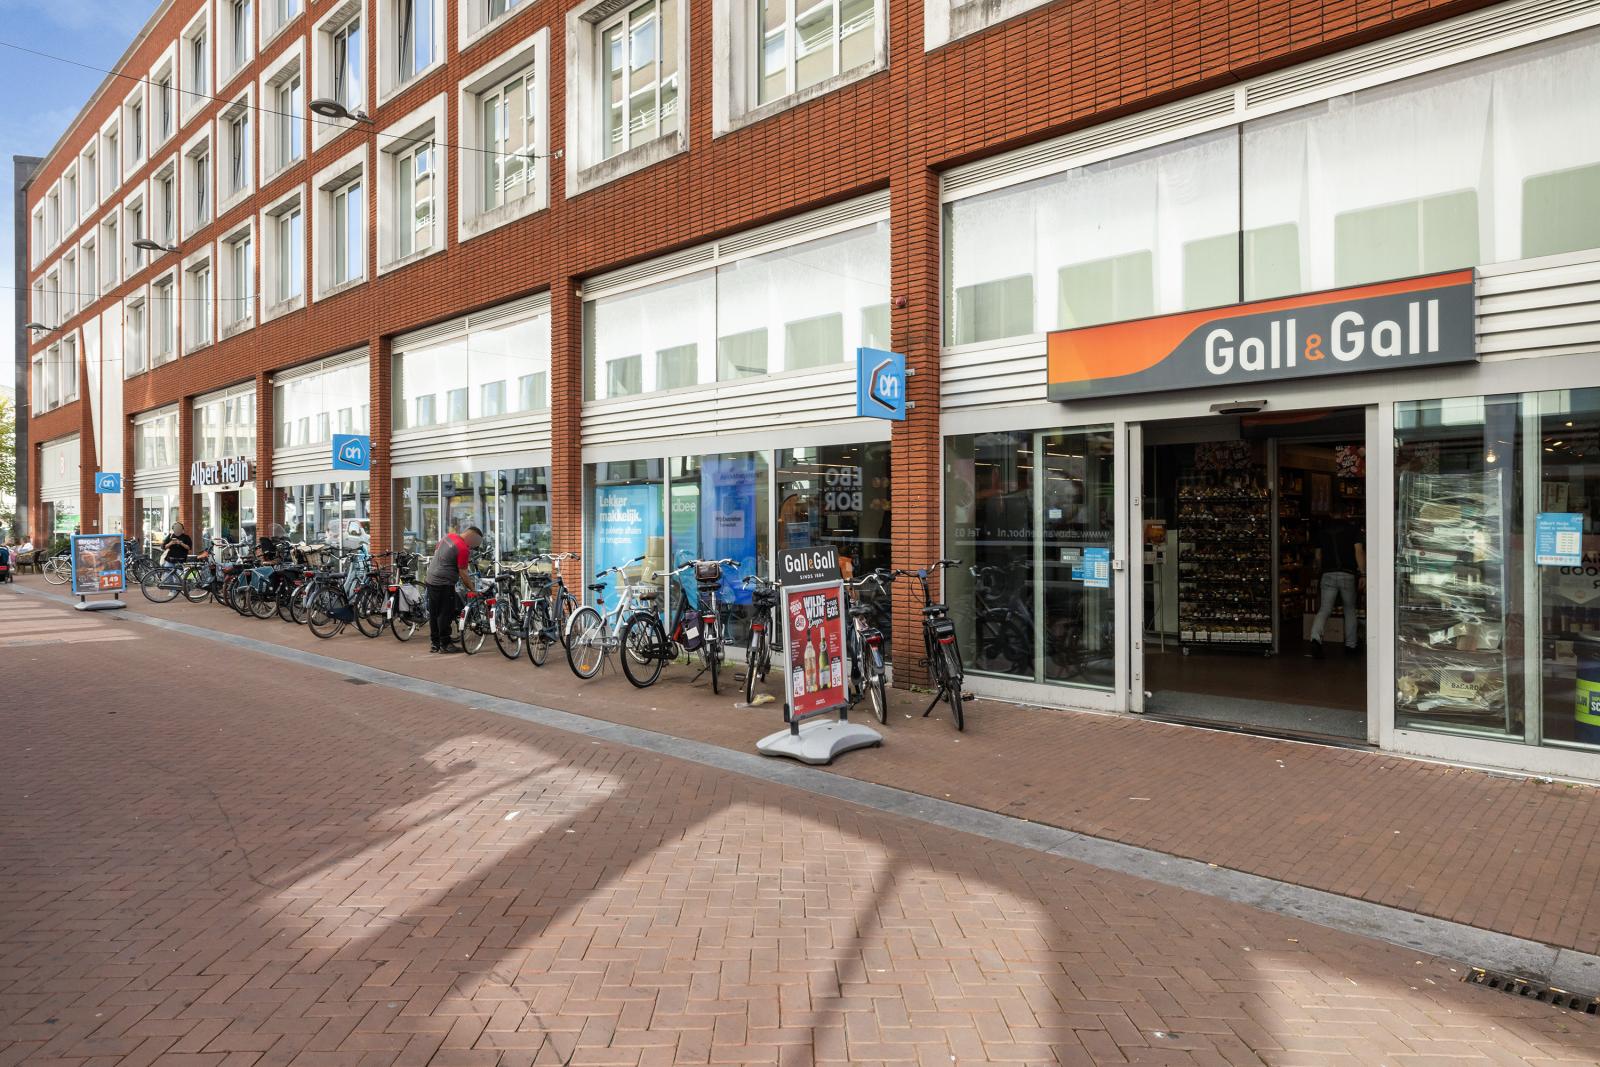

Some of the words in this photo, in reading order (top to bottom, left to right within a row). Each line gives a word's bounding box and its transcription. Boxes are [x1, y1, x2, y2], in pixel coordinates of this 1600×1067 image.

[190, 462, 219, 486] Albert
[221, 456, 249, 488] Heijn
[600, 494, 628, 507] Lekker
[600, 508, 642, 525] makkelijk.
[803, 595, 826, 608] WILDE
[805, 605, 825, 619] WIJN
